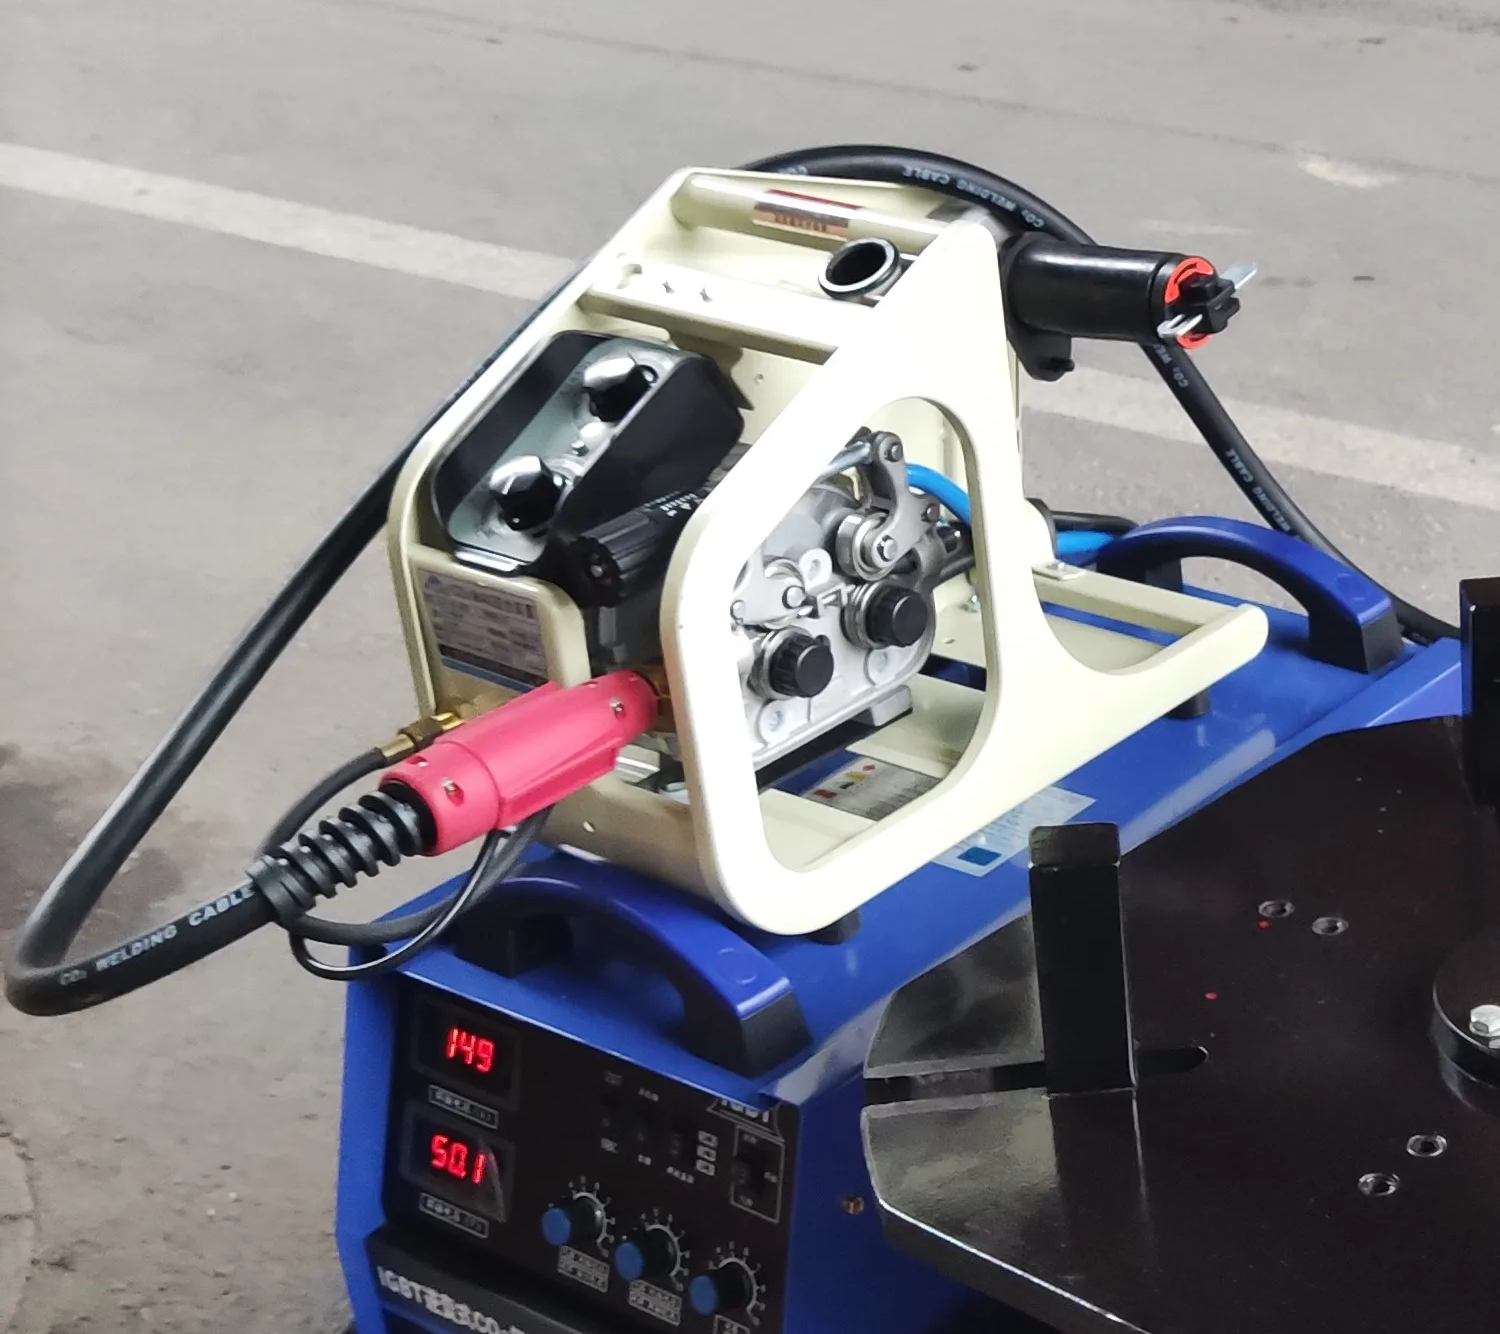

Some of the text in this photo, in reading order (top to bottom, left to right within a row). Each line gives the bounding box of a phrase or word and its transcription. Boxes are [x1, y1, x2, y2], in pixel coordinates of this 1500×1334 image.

[902, 166, 951, 185] CABLE
[956, 178, 1017, 213] WELDING
[95, 924, 178, 972] WELDING
[187, 883, 255, 927] CABLE
[446, 1028, 495, 1072] 149
